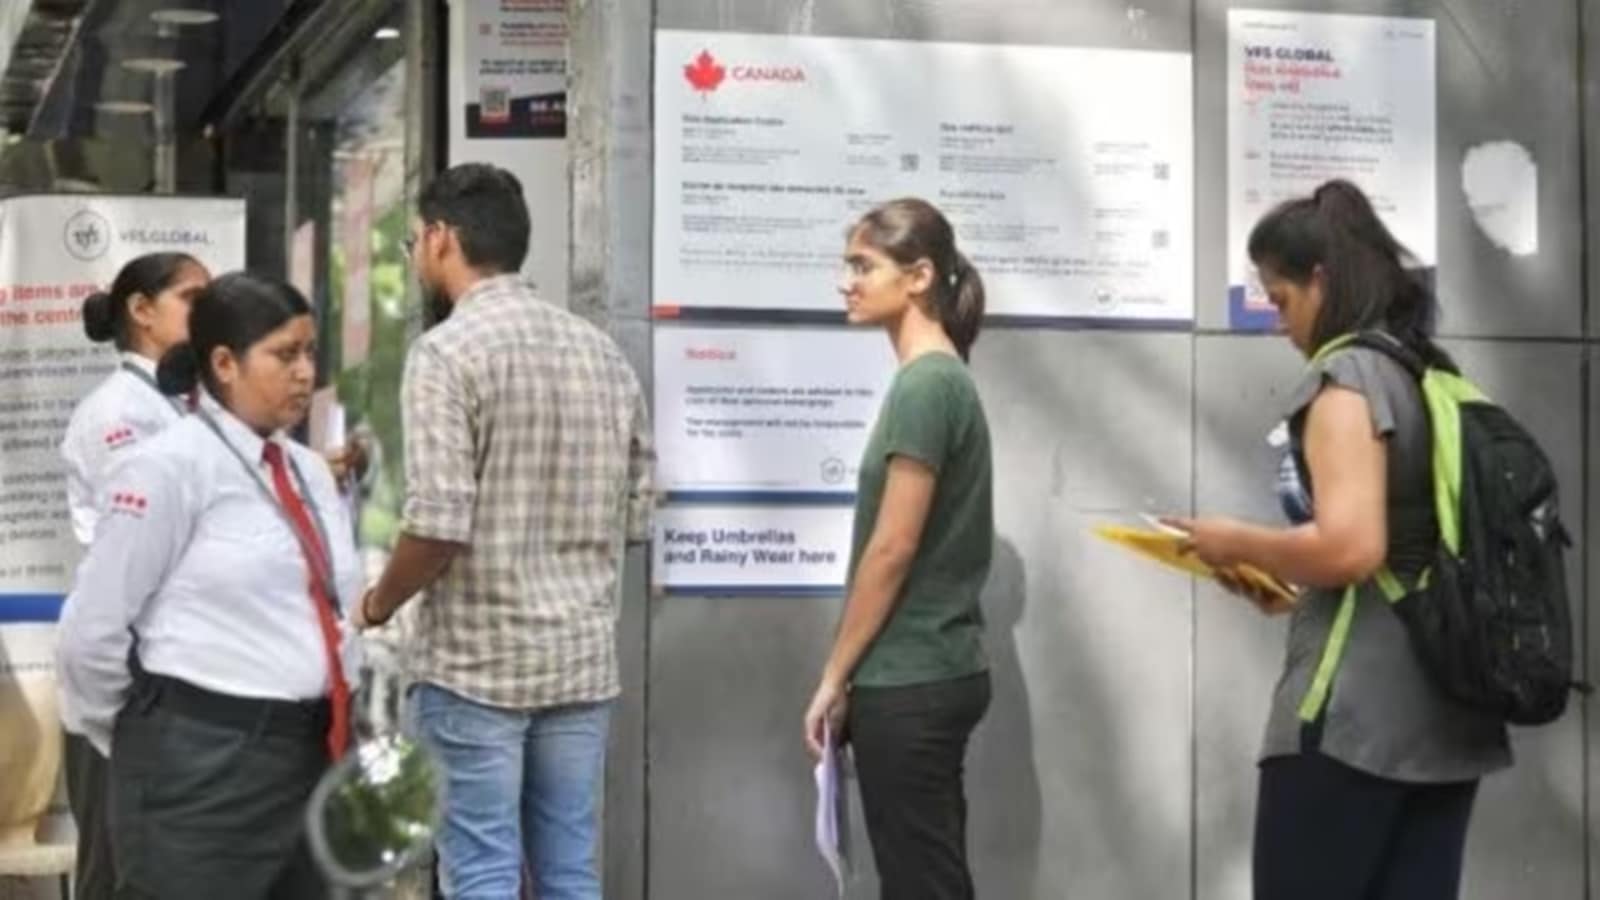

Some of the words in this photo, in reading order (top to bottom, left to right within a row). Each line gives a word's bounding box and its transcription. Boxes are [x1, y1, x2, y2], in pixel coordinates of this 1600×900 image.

[732, 66, 806, 82] CANADA
[14, 284, 65, 301] items
[664, 529, 707, 545] Keep
[712, 529, 796, 544] Umbrellas
[664, 550, 695, 564] and
[700, 550, 748, 567] Rainy
[751, 550, 795, 564] Wear
[799, 550, 836, 564] here
